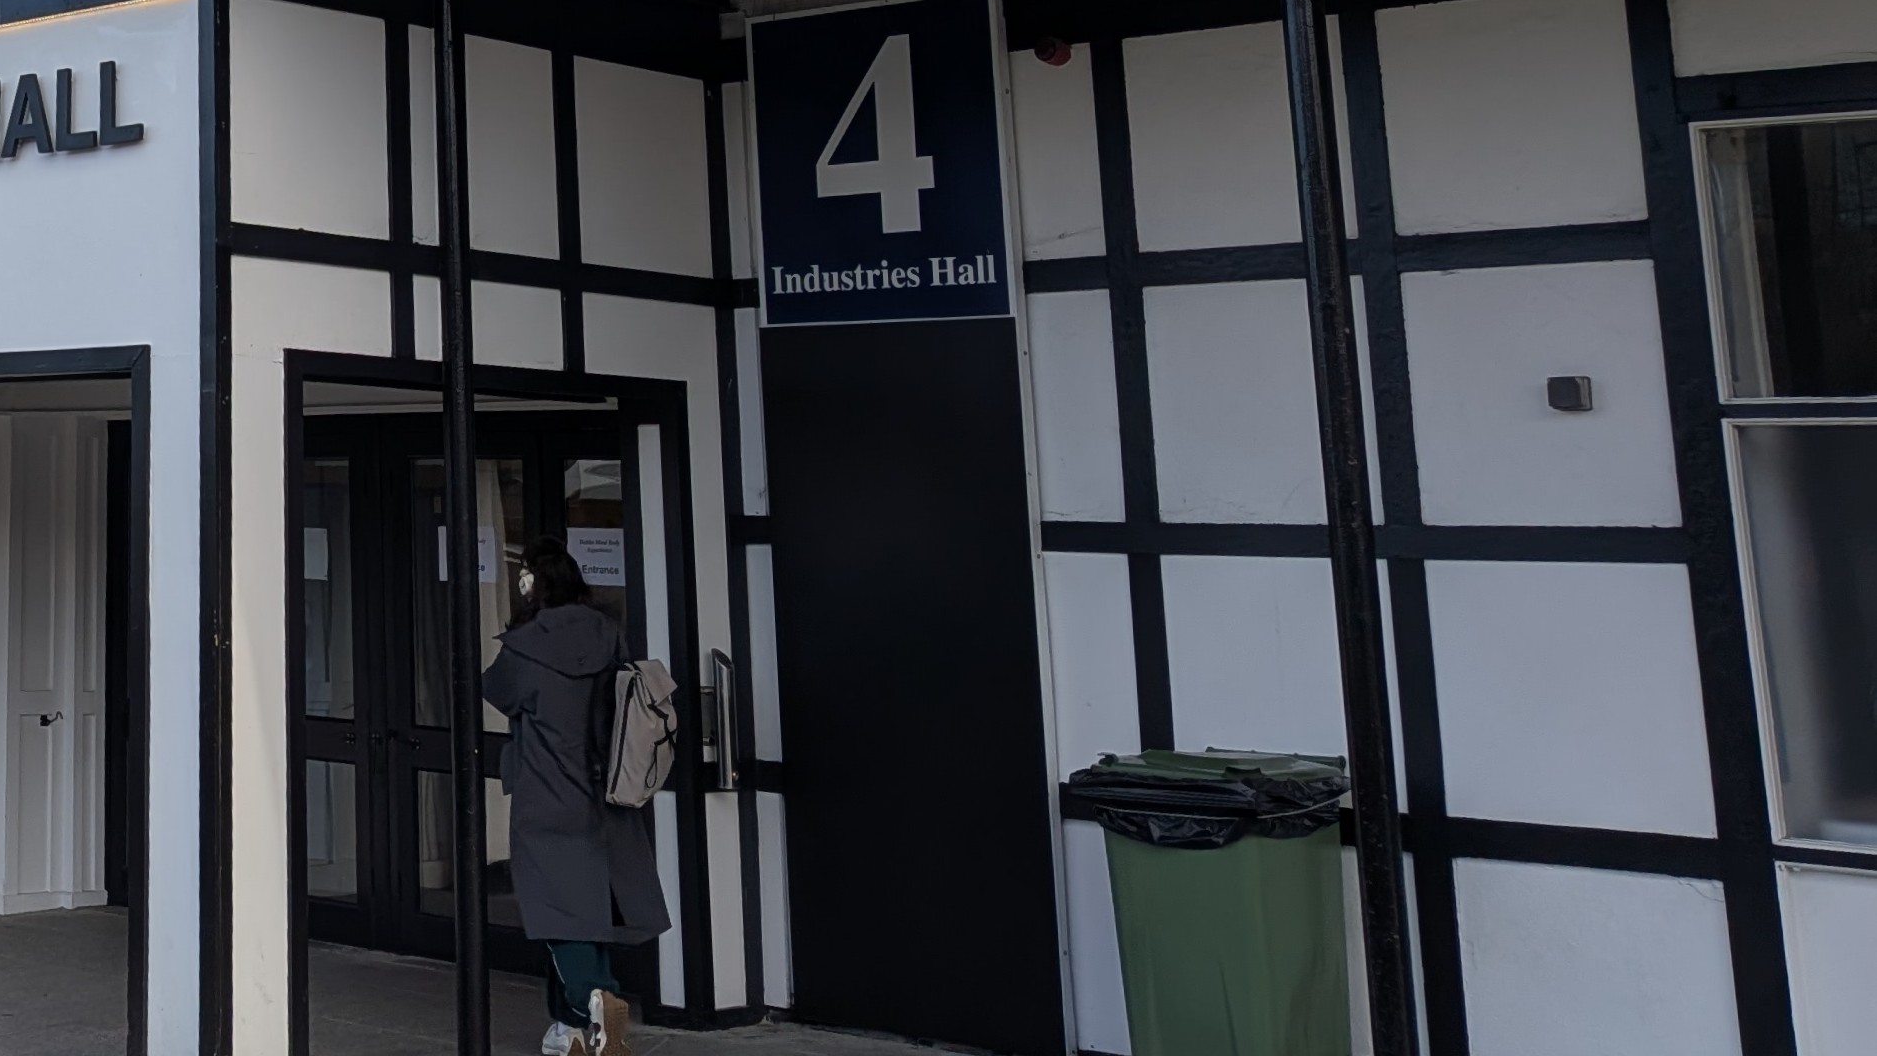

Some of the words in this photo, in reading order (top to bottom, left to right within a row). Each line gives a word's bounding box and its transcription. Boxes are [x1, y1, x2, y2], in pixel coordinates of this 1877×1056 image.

[816, 33, 935, 234] 4
[772, 259, 921, 294] Industries
[928, 254, 997, 287] Hall
[582, 564, 620, 575] Entrance
